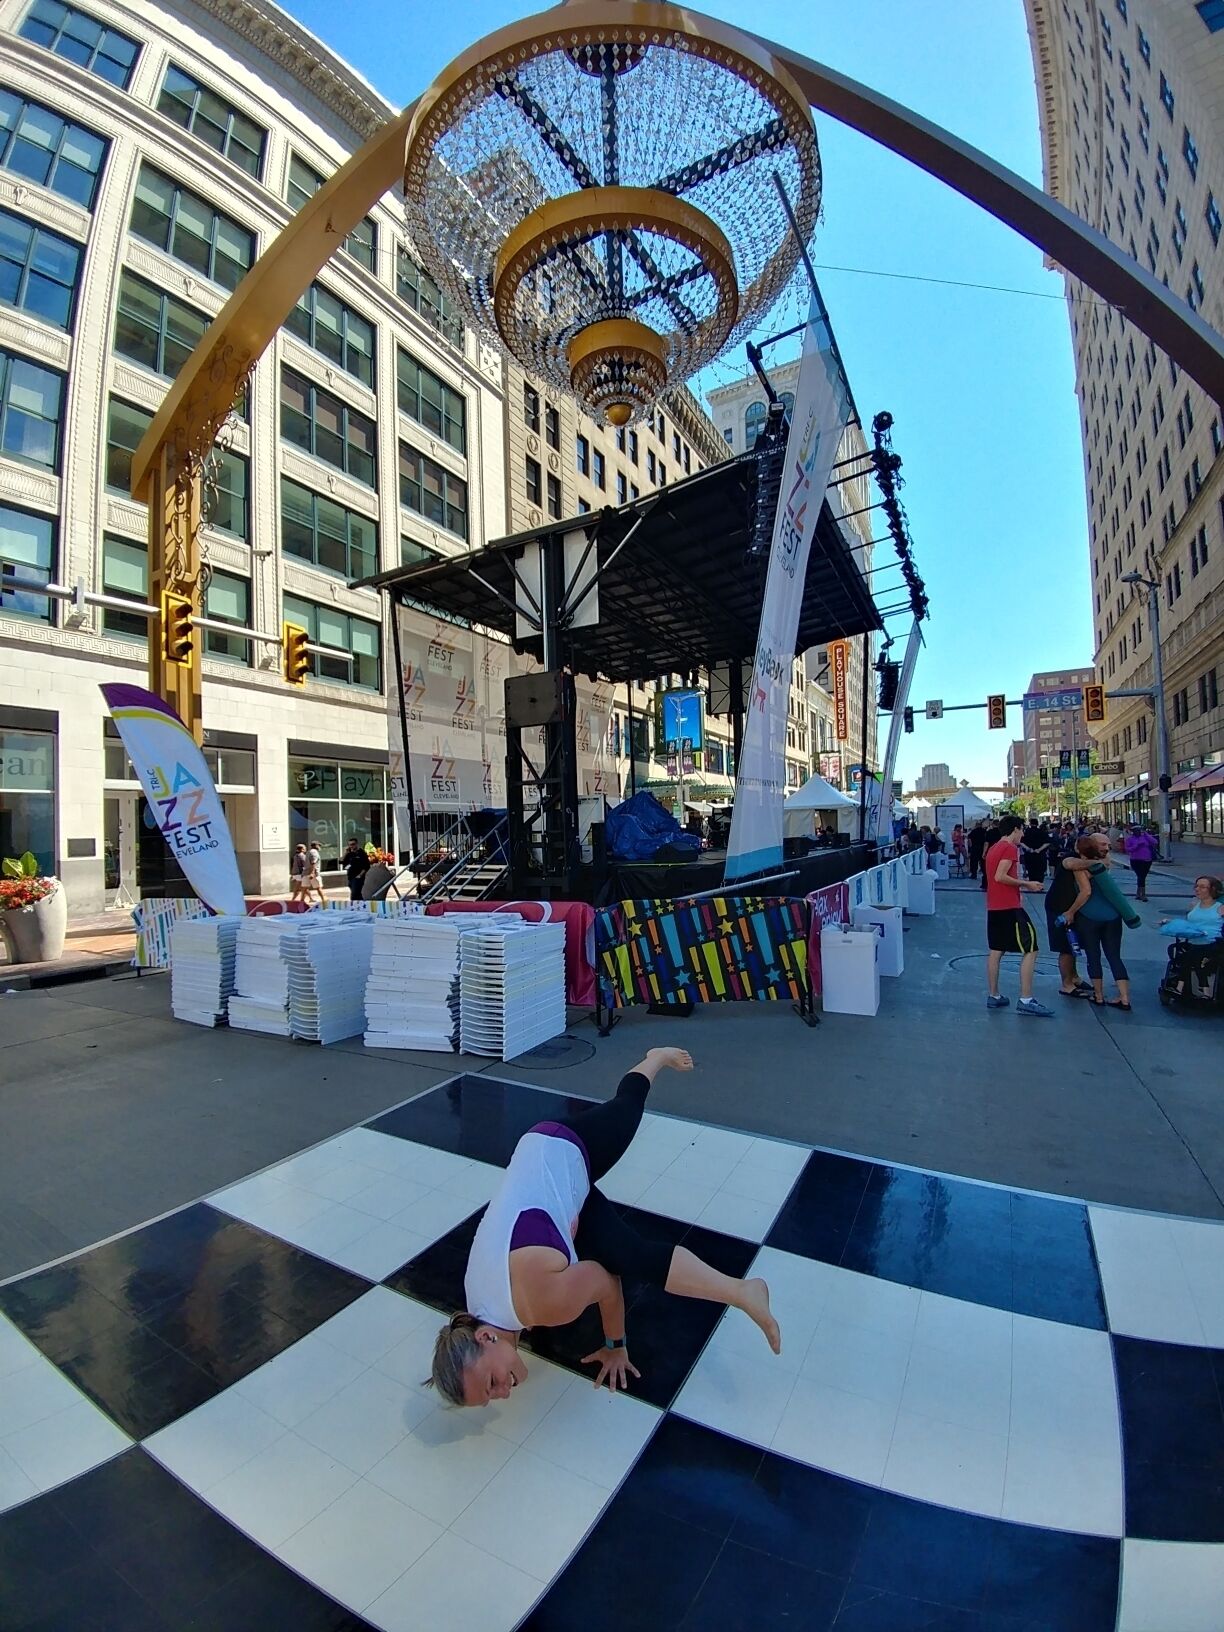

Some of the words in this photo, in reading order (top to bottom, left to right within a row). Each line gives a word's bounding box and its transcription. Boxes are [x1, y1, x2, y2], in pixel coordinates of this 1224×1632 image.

[779, 511, 802, 561] FEST
[427, 645, 455, 664] FEST
[836, 647, 844, 700] PLAYHOUSE
[1028, 699, 1040, 709] E.
[1043, 696, 1059, 708] 14
[1062, 695, 1077, 705] St
[452, 717, 475, 731] FEST
[837, 701, 846, 737] SQUARE
[431, 757, 456, 780] ZZ
[431, 780, 457, 792] FEST
